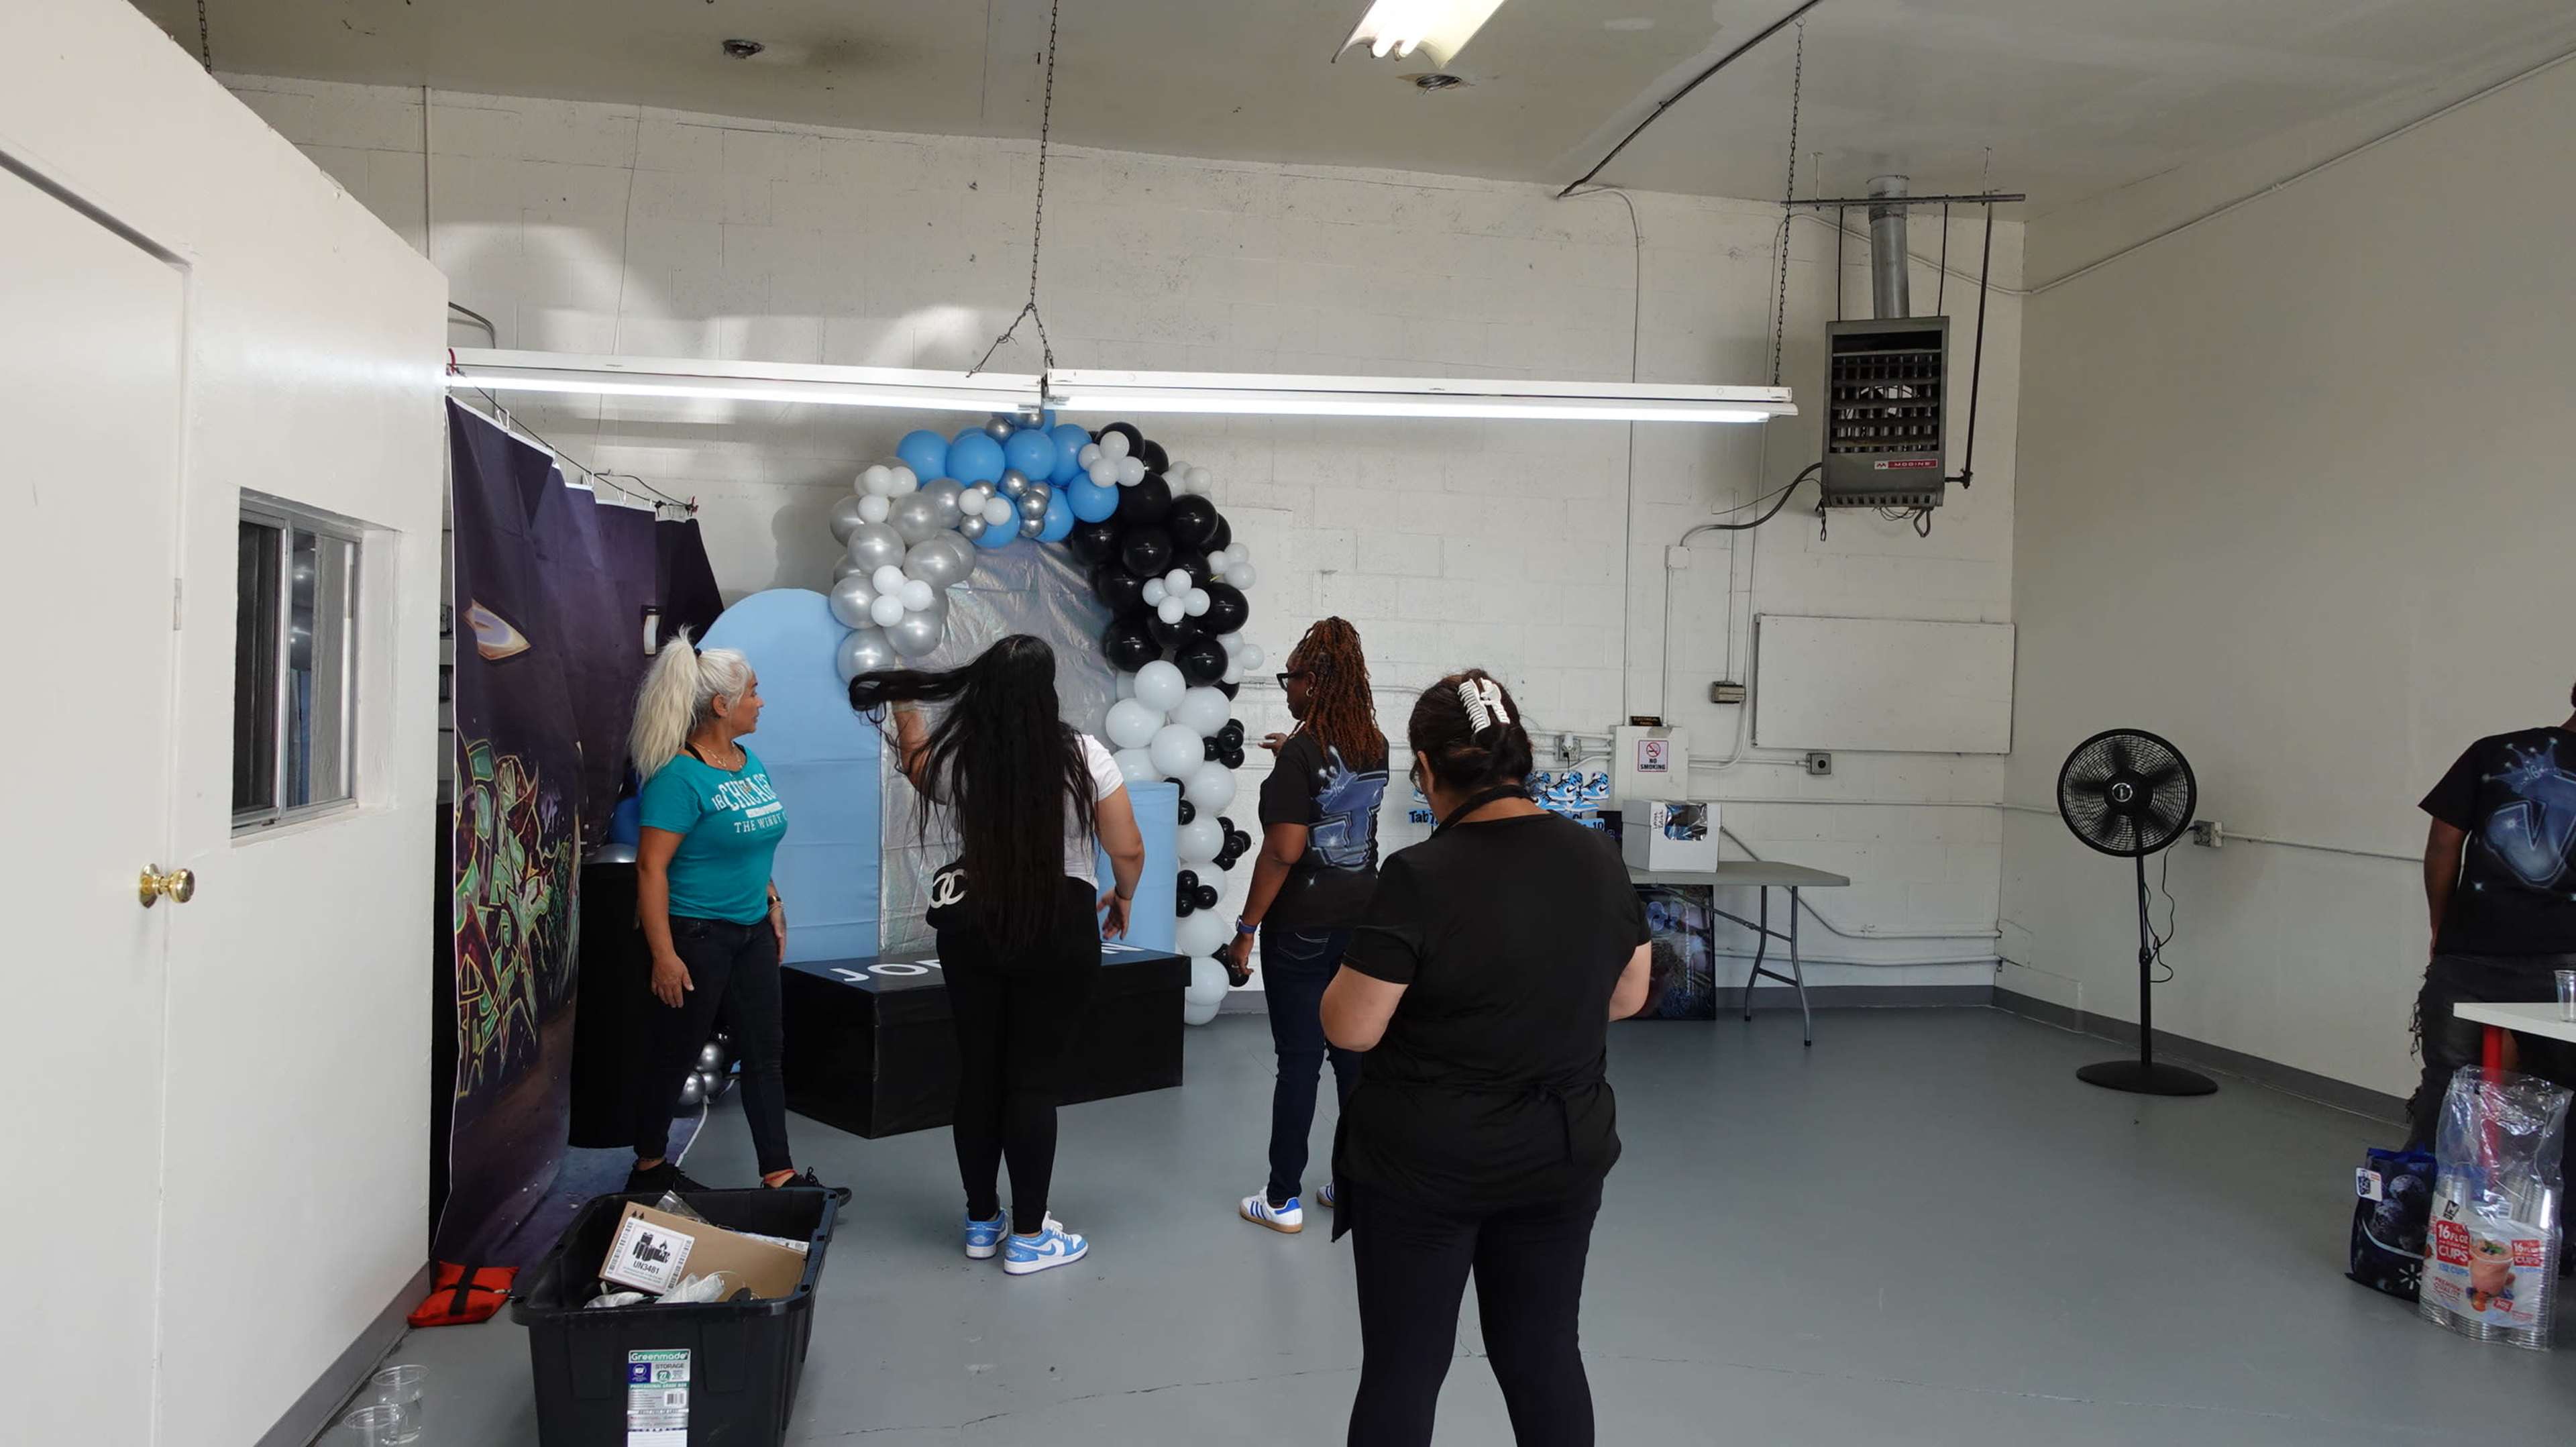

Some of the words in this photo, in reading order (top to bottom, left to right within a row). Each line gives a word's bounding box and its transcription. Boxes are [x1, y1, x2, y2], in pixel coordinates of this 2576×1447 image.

[734, 820, 756, 833] THE
[1593, 821, 1604, 830] 10
[2438, 1224, 2451, 1239] 16
[2438, 1245, 2469, 1262] CUPS
[633, 1261, 660, 1275] UN3481
[631, 1352, 686, 1360] Greenmade
